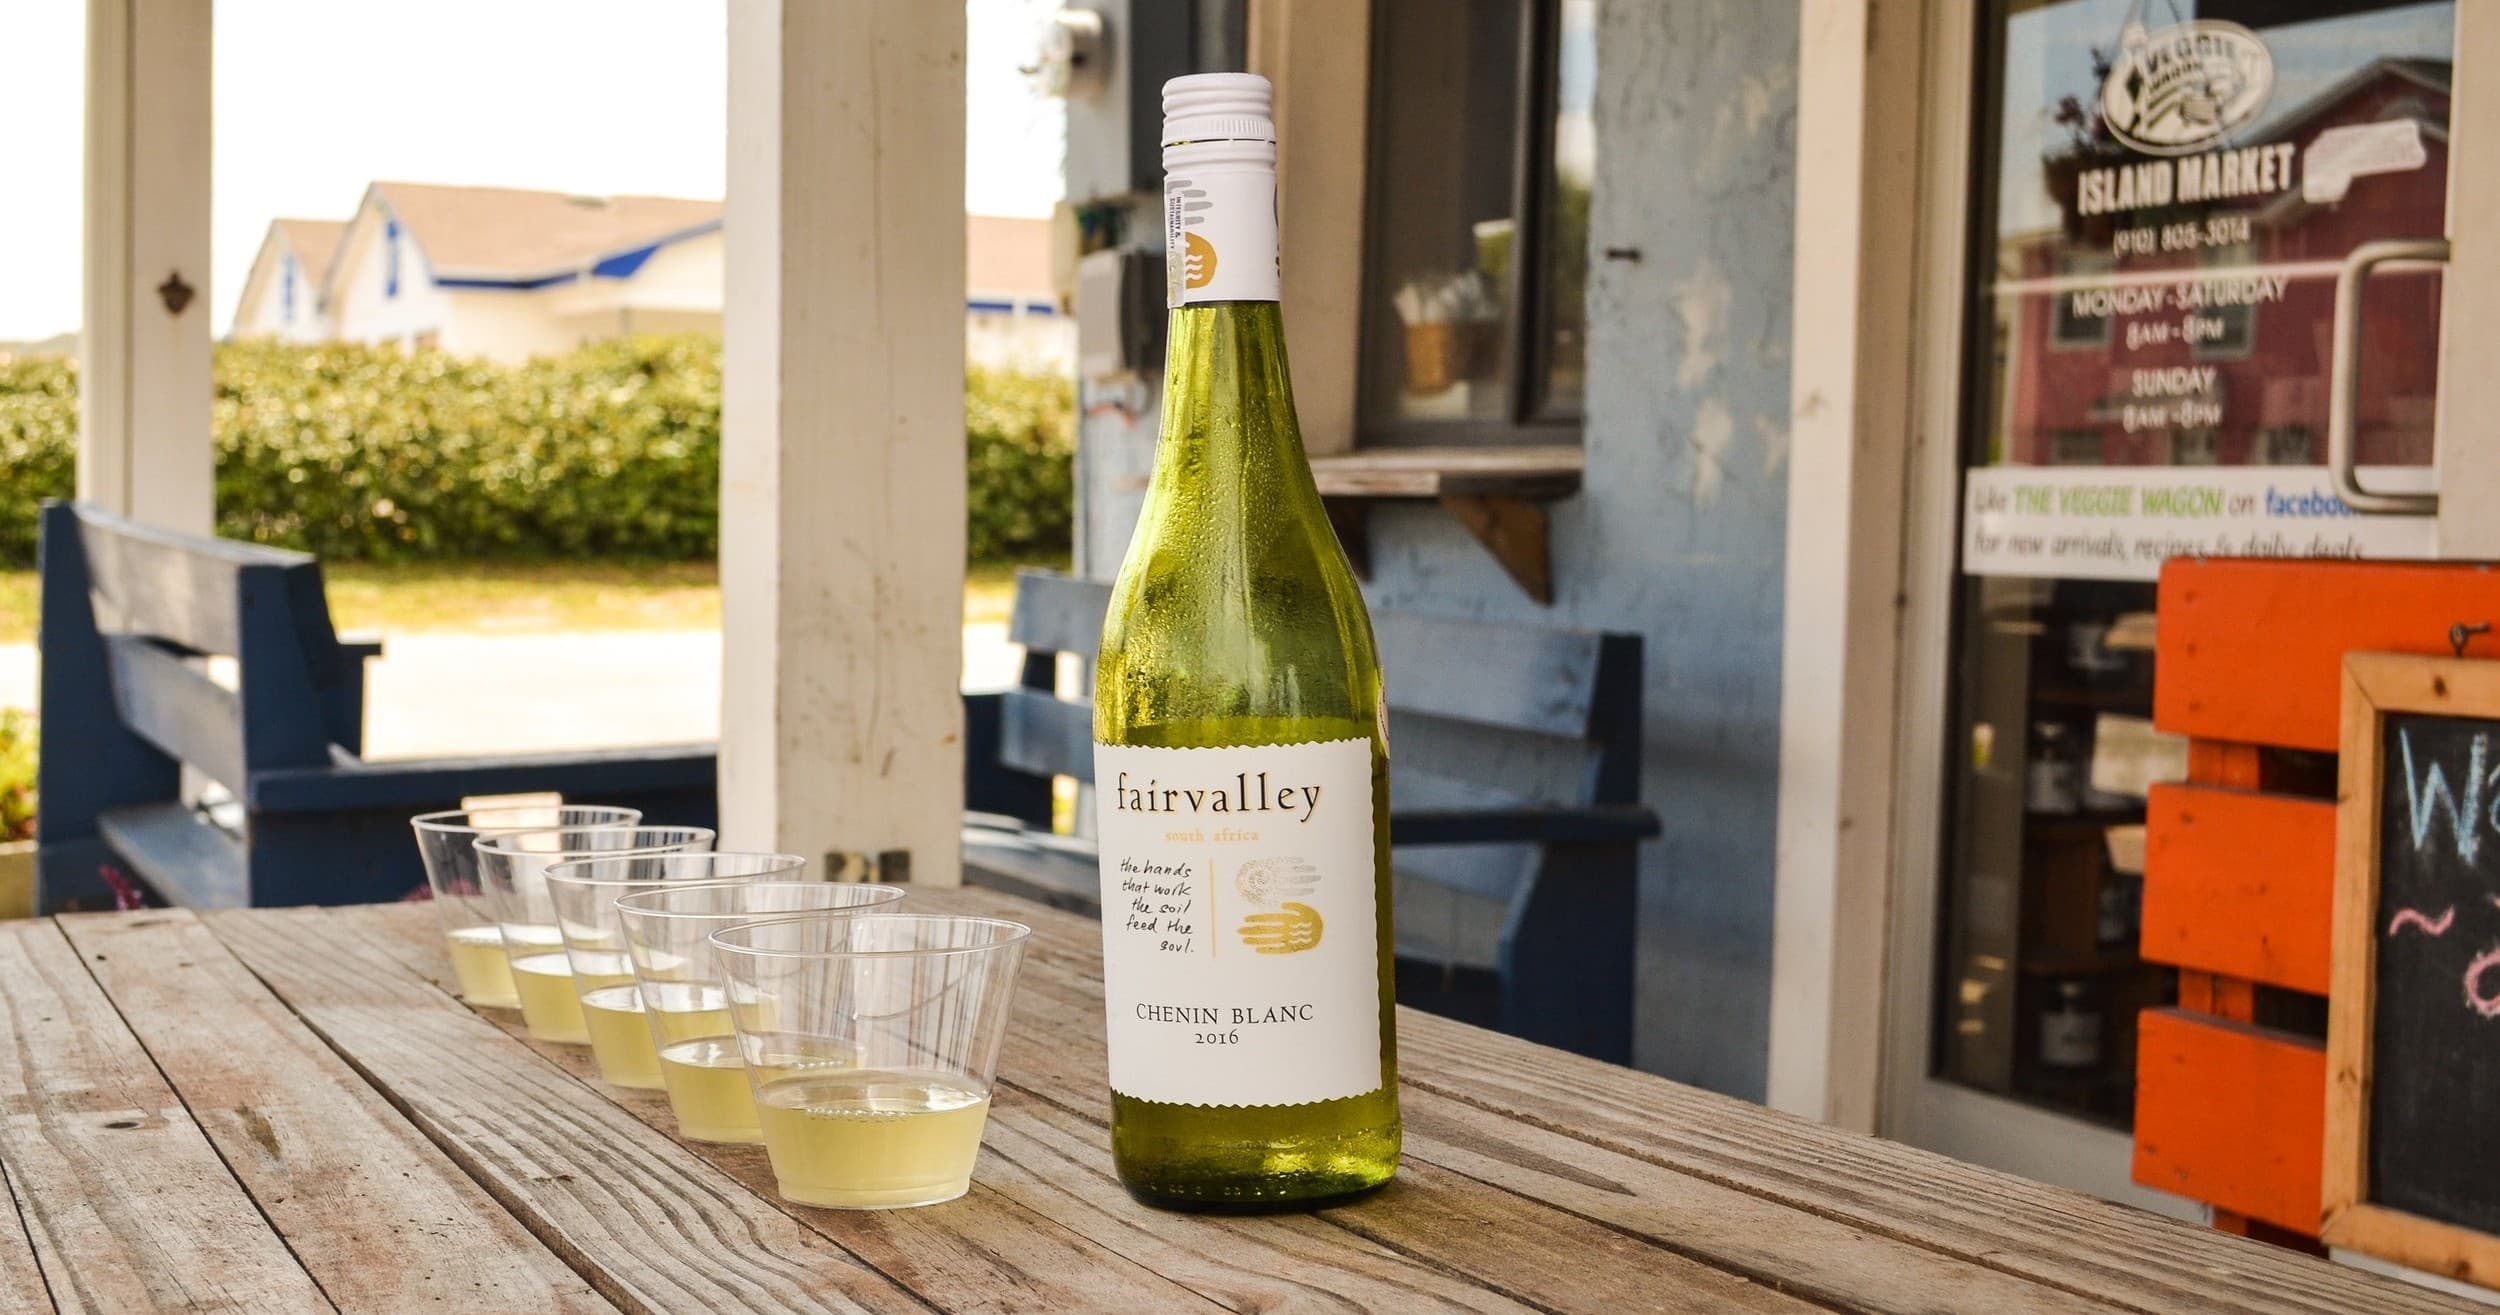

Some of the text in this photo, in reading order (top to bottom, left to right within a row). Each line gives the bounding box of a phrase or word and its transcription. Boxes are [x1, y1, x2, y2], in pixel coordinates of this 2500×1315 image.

[2077, 142, 2295, 216] ISLAND MARKET
[2113, 228, 2156, 259] (910)
[2131, 365, 2217, 397] SUNDAY
[2015, 484, 2053, 515] THE
[2058, 484, 2133, 516] VEGGIE
[2140, 484, 2225, 517] WAGON
[2227, 494, 2255, 515] on
[2008, 534, 2044, 554] new
[1117, 772, 1321, 823] fairvalley
[1164, 825, 1260, 842] south africa
[1120, 857, 1192, 878] the hands
[1122, 877, 1192, 896] that work
[1132, 896, 1192, 914] the soil
[1126, 914, 1193, 934] feed the
[1160, 938, 1194, 953] soul.
[1136, 1003, 1314, 1025] CHENIN BLANC
[1194, 1029, 1240, 1045] 2016
